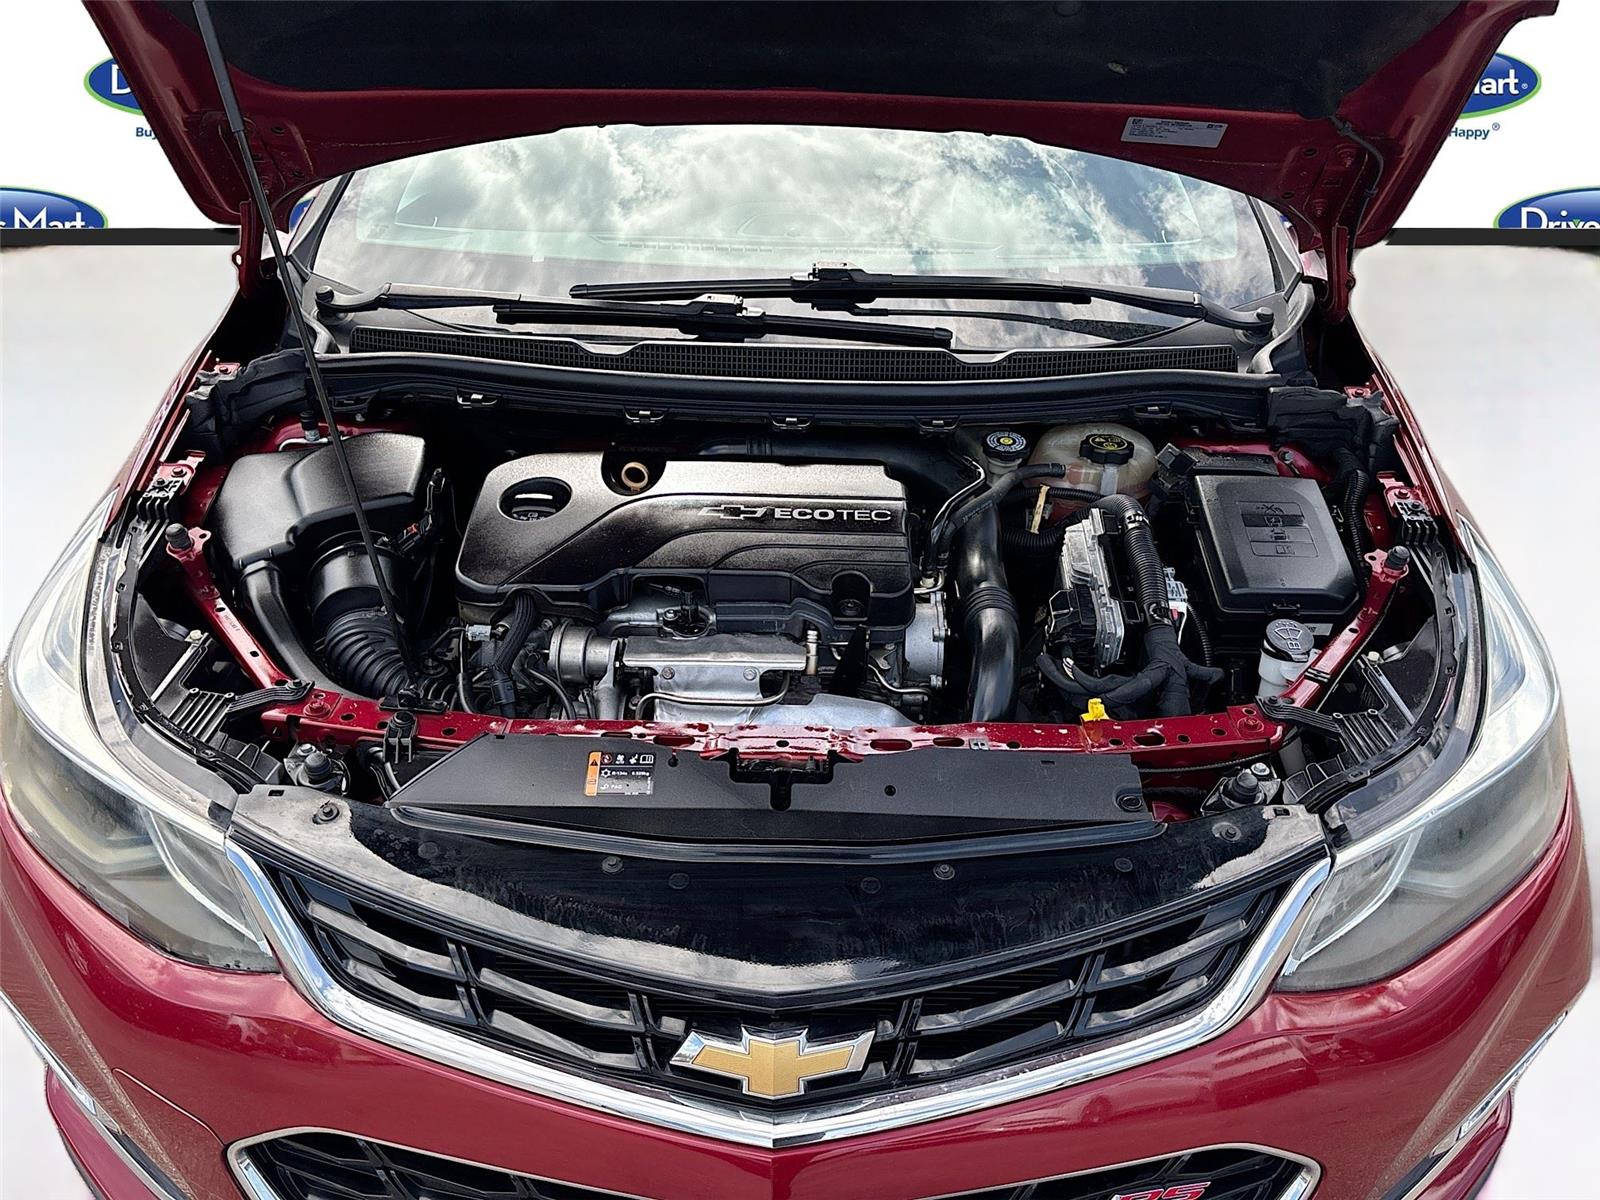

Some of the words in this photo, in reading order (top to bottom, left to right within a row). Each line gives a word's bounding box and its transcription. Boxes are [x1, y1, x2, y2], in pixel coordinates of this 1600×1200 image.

[1473, 69, 1519, 94] art
[135, 127, 157, 140] Bu
[1449, 127, 1490, 140] Happy
[774, 508, 892, 521] ECOTEC
